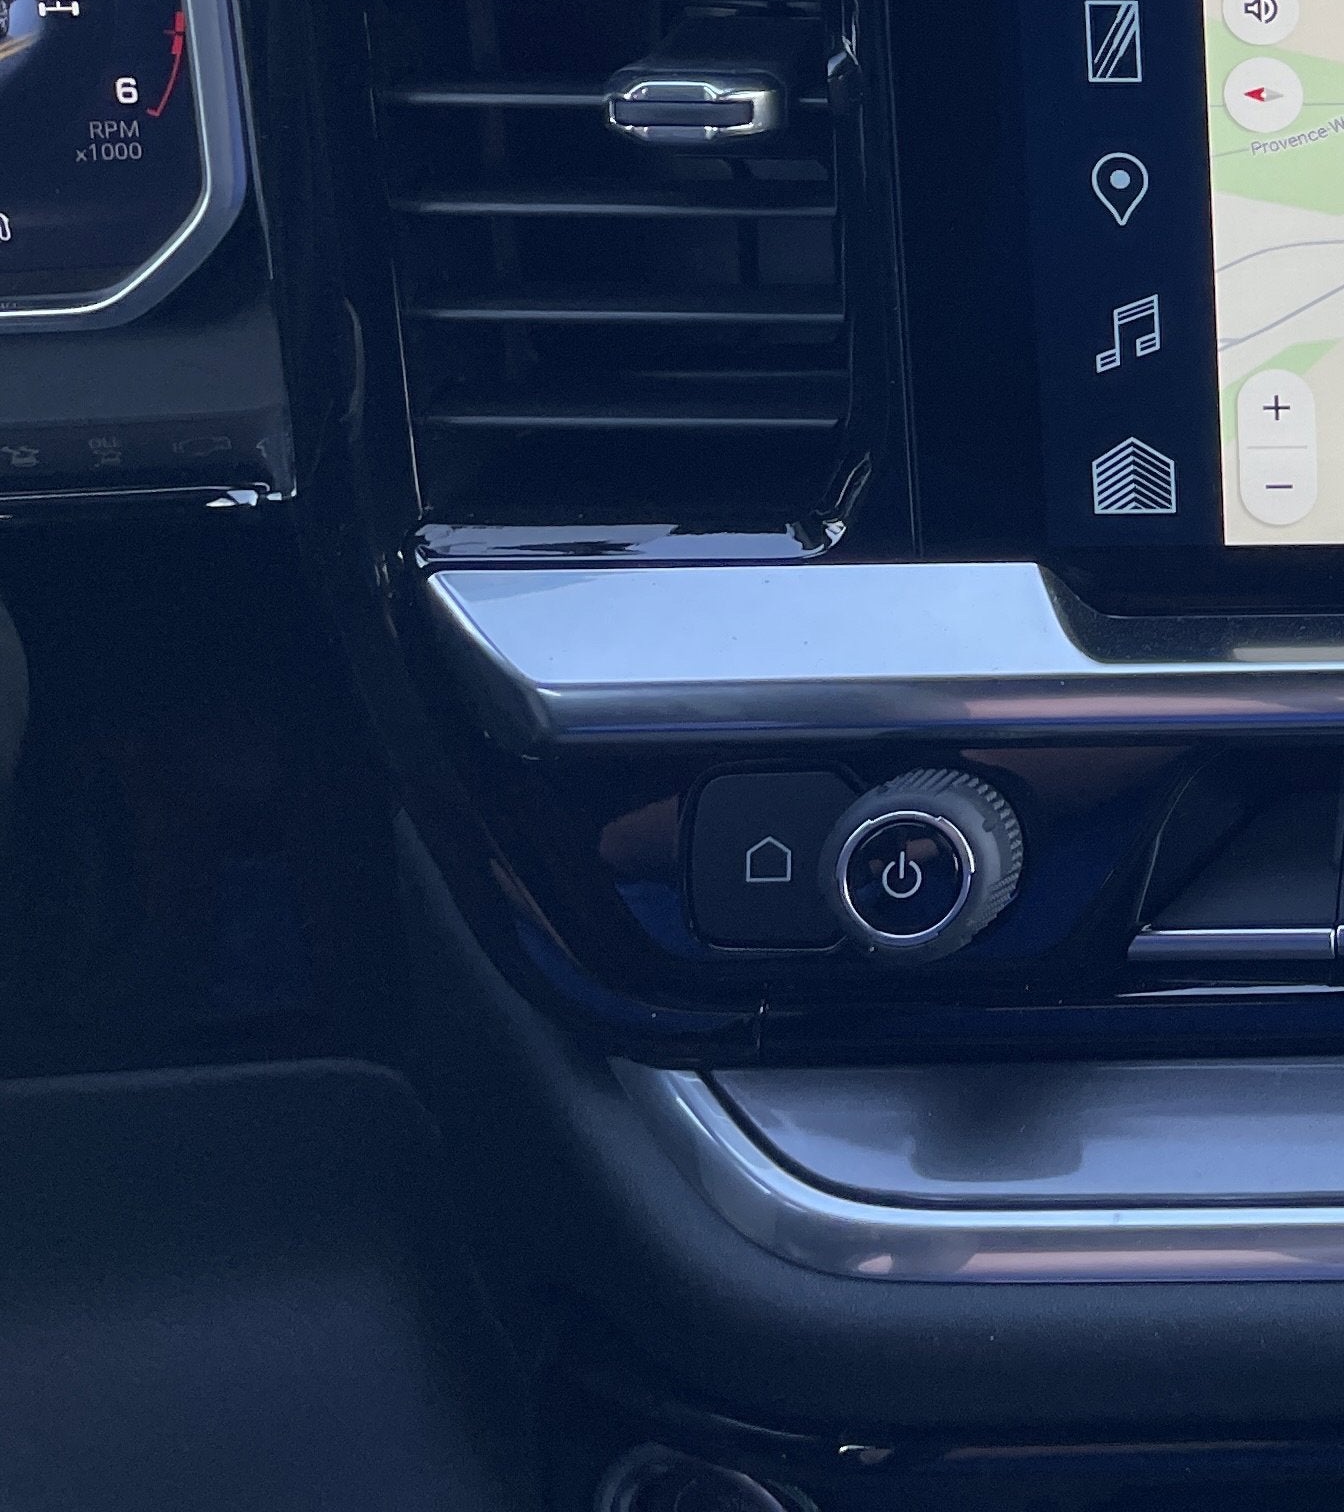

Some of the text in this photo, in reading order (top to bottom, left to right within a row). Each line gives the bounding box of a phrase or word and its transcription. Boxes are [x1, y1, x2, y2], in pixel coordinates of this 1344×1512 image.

[115, 77, 139, 105] 6
[89, 121, 140, 139] RPM
[1250, 125, 1329, 156] Provence
[75, 143, 142, 162] x1000
